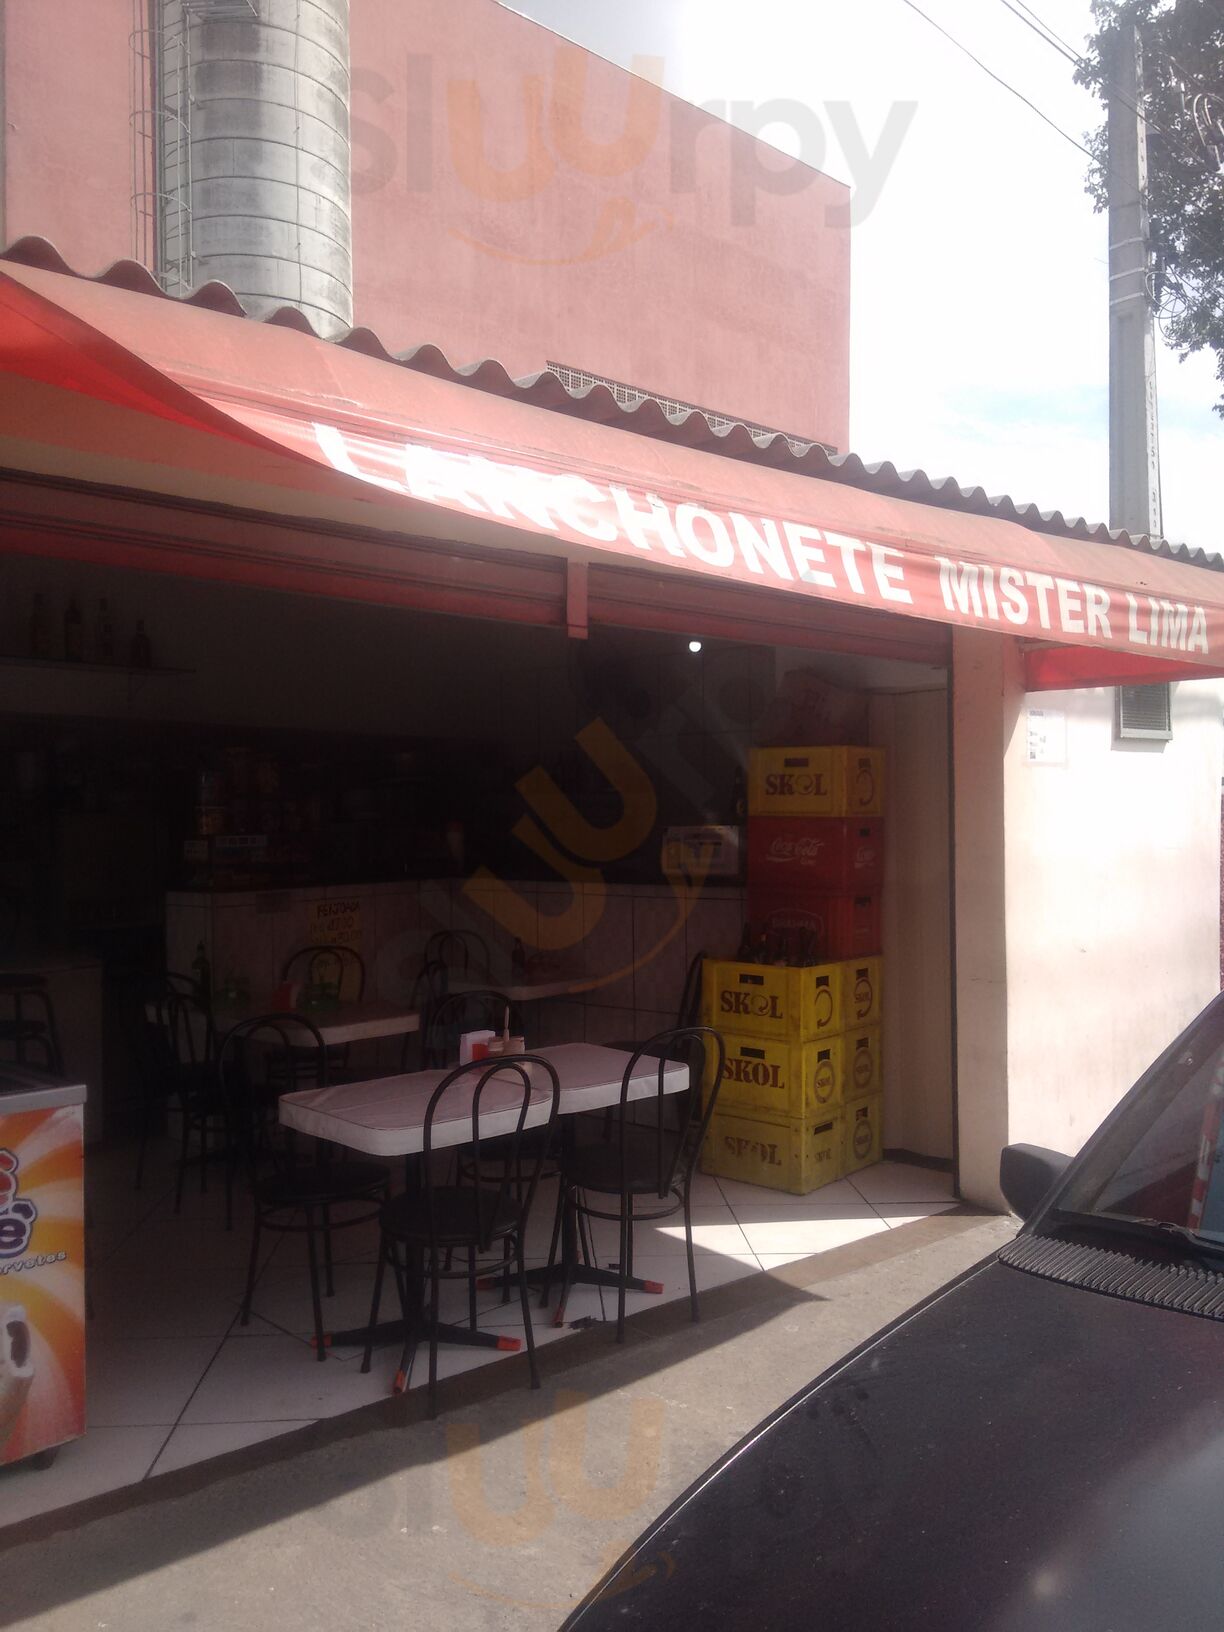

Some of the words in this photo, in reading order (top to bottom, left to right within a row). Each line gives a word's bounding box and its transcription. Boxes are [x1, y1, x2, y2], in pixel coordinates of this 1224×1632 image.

[312, 421, 913, 604] LANCHONETE
[934, 555, 1112, 639] MISTER
[1125, 592, 1209, 654] LIMA
[765, 773, 828, 796] SKOL
[720, 990, 783, 1019] SKOL
[723, 1058, 785, 1089] SKOL
[0, 1250, 66, 1275] rvetes
